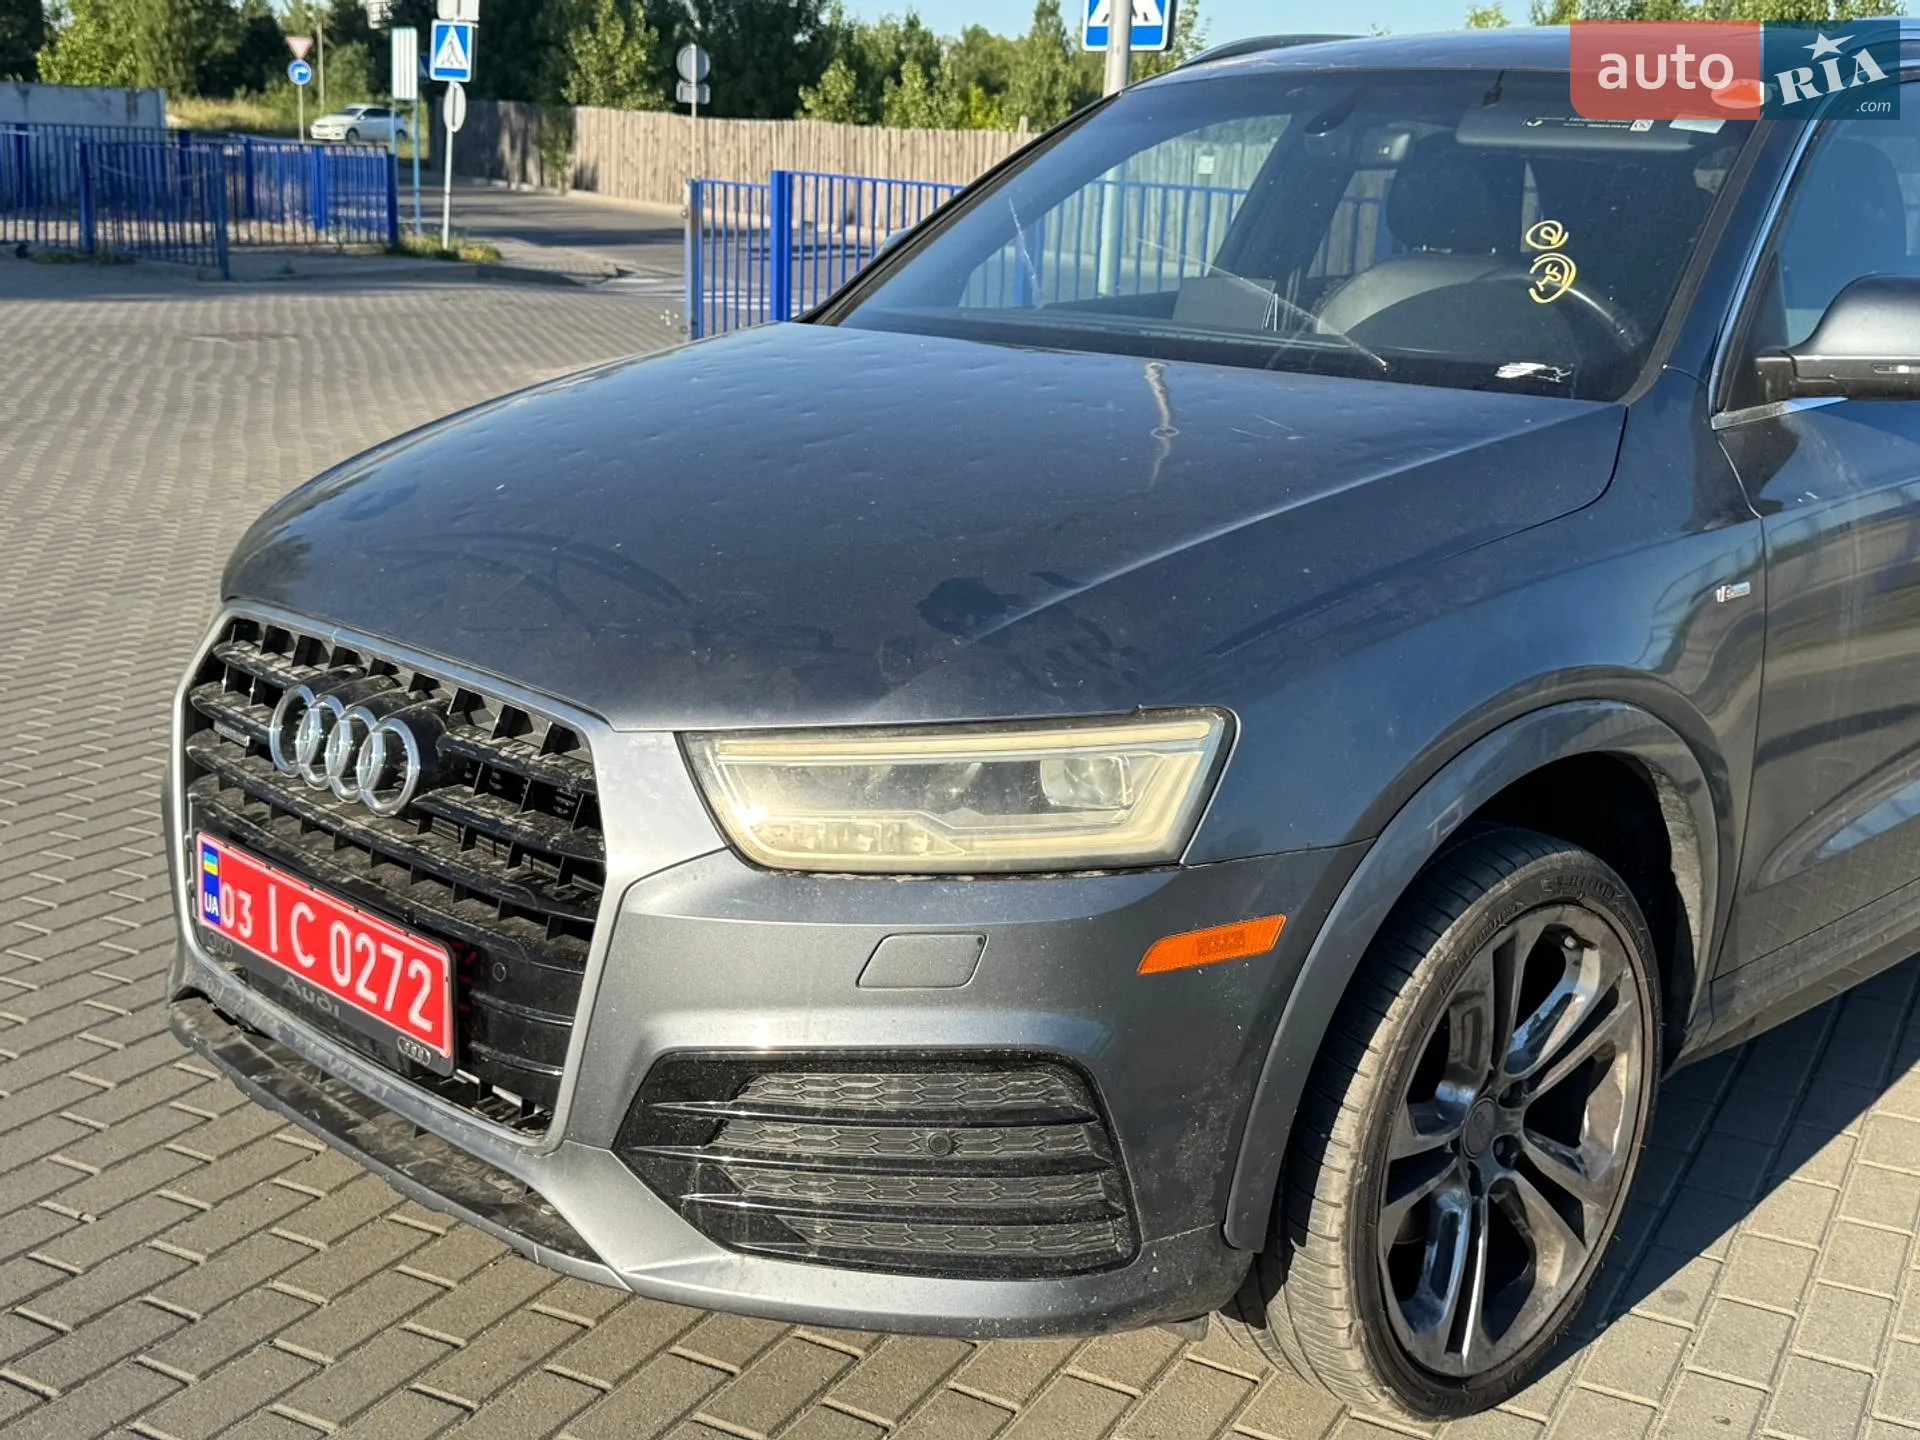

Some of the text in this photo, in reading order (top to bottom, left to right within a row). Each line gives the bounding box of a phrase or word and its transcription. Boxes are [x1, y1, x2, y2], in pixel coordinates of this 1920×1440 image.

[203, 891, 220, 917] UA
[219, 880, 254, 939] 03
[329, 919, 433, 1033] 0272
